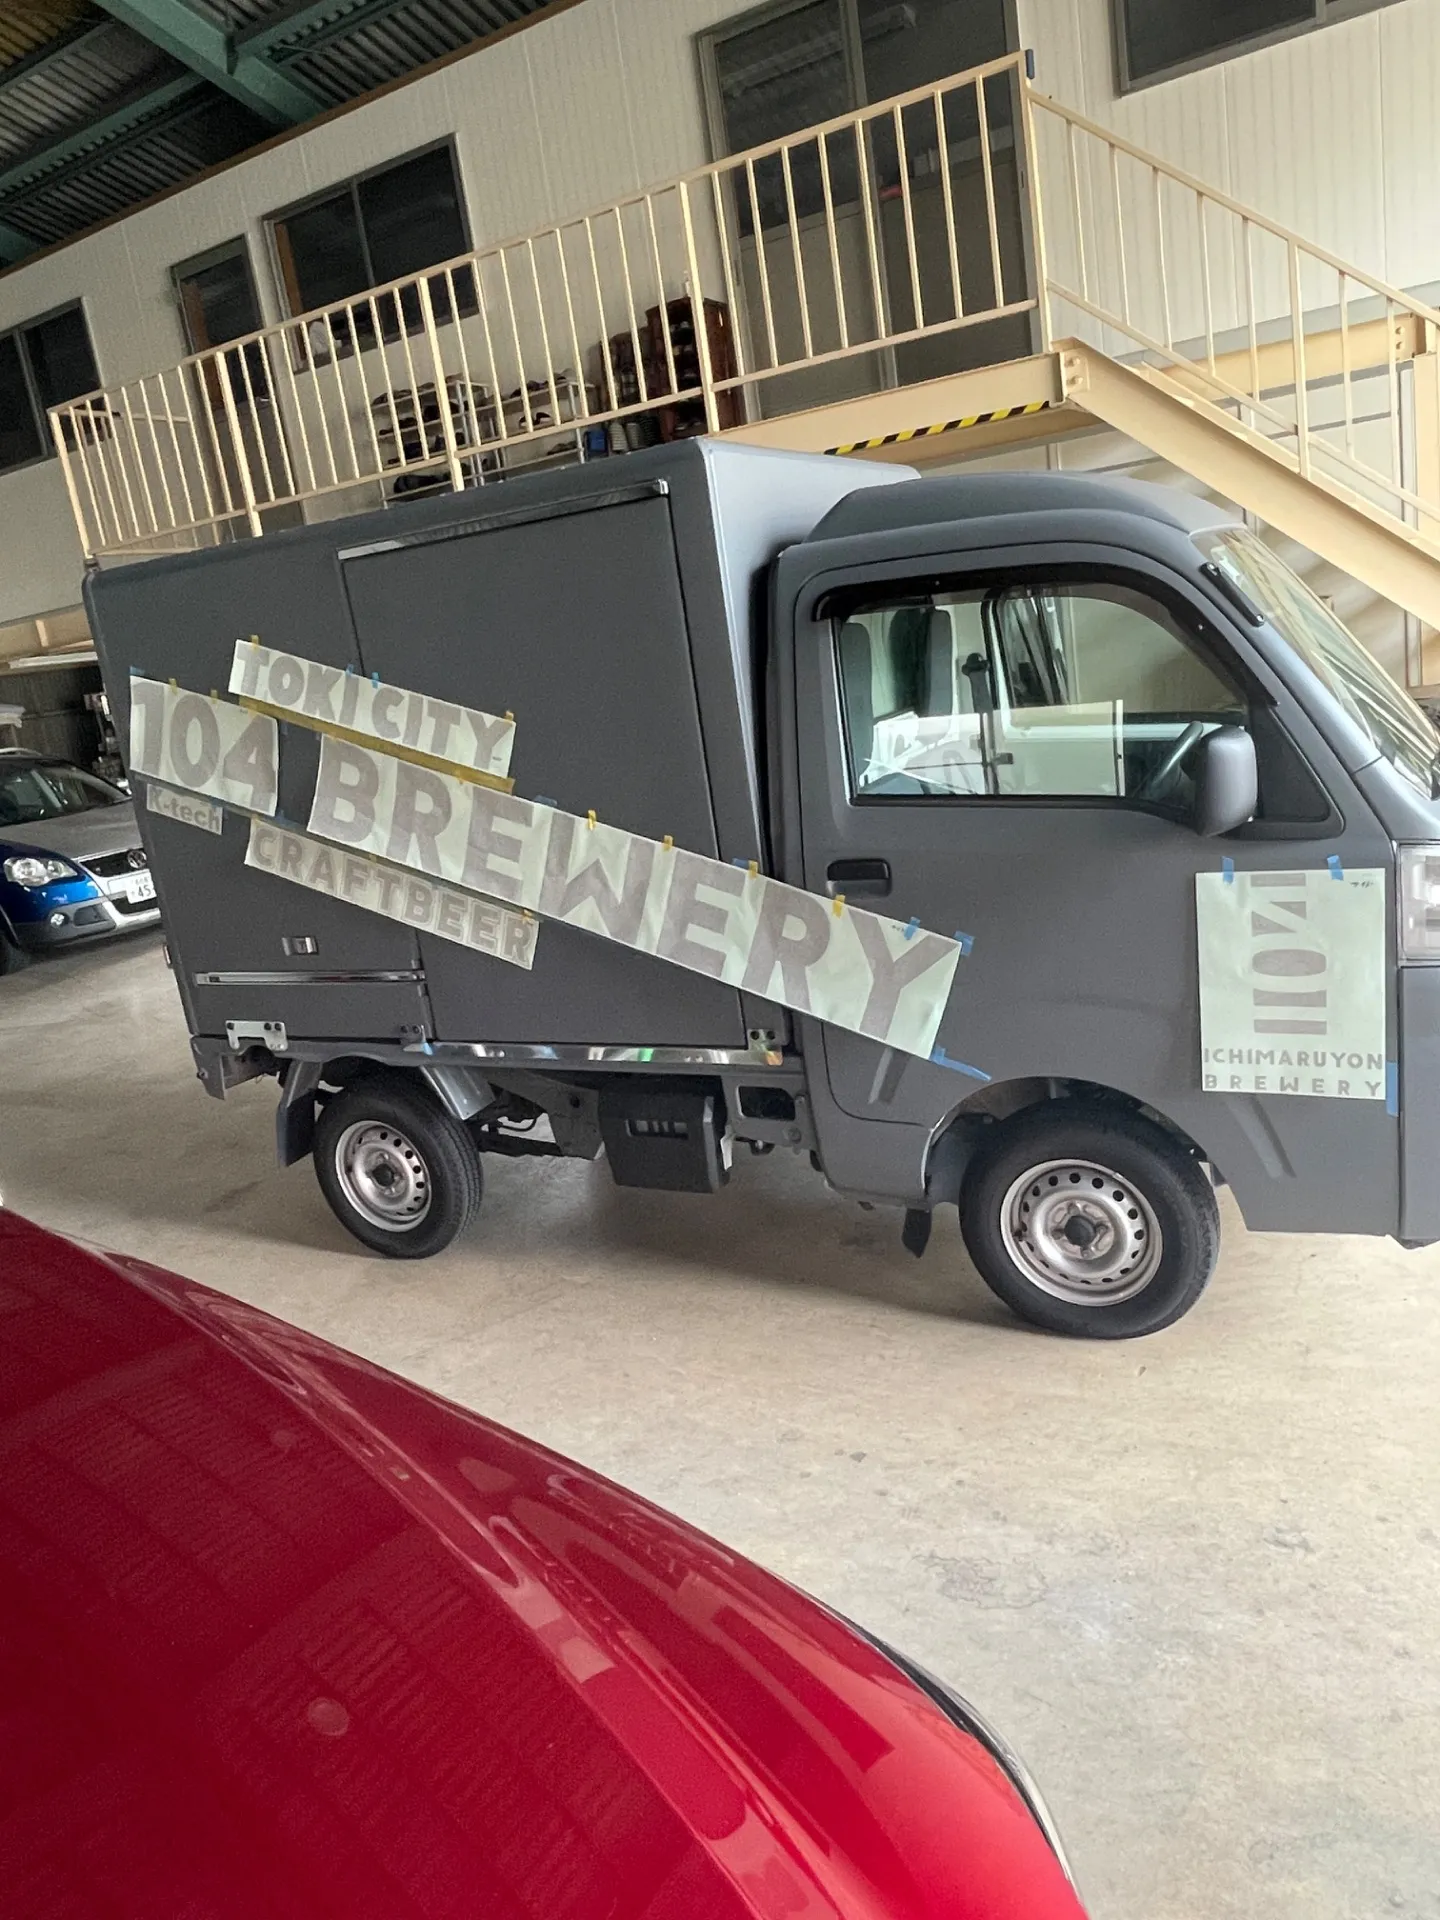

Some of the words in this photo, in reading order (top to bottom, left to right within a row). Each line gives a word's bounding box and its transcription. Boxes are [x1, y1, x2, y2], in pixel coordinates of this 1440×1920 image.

[236, 649, 360, 726] TOKI
[371, 684, 512, 769] CITY
[148, 785, 222, 832] K-tech
[133, 680, 277, 813] 104
[313, 735, 961, 1041] BREWERY
[1203, 1047, 1383, 1070] ICHIMARUYON
[1203, 1074, 1382, 1098] BREWERY
